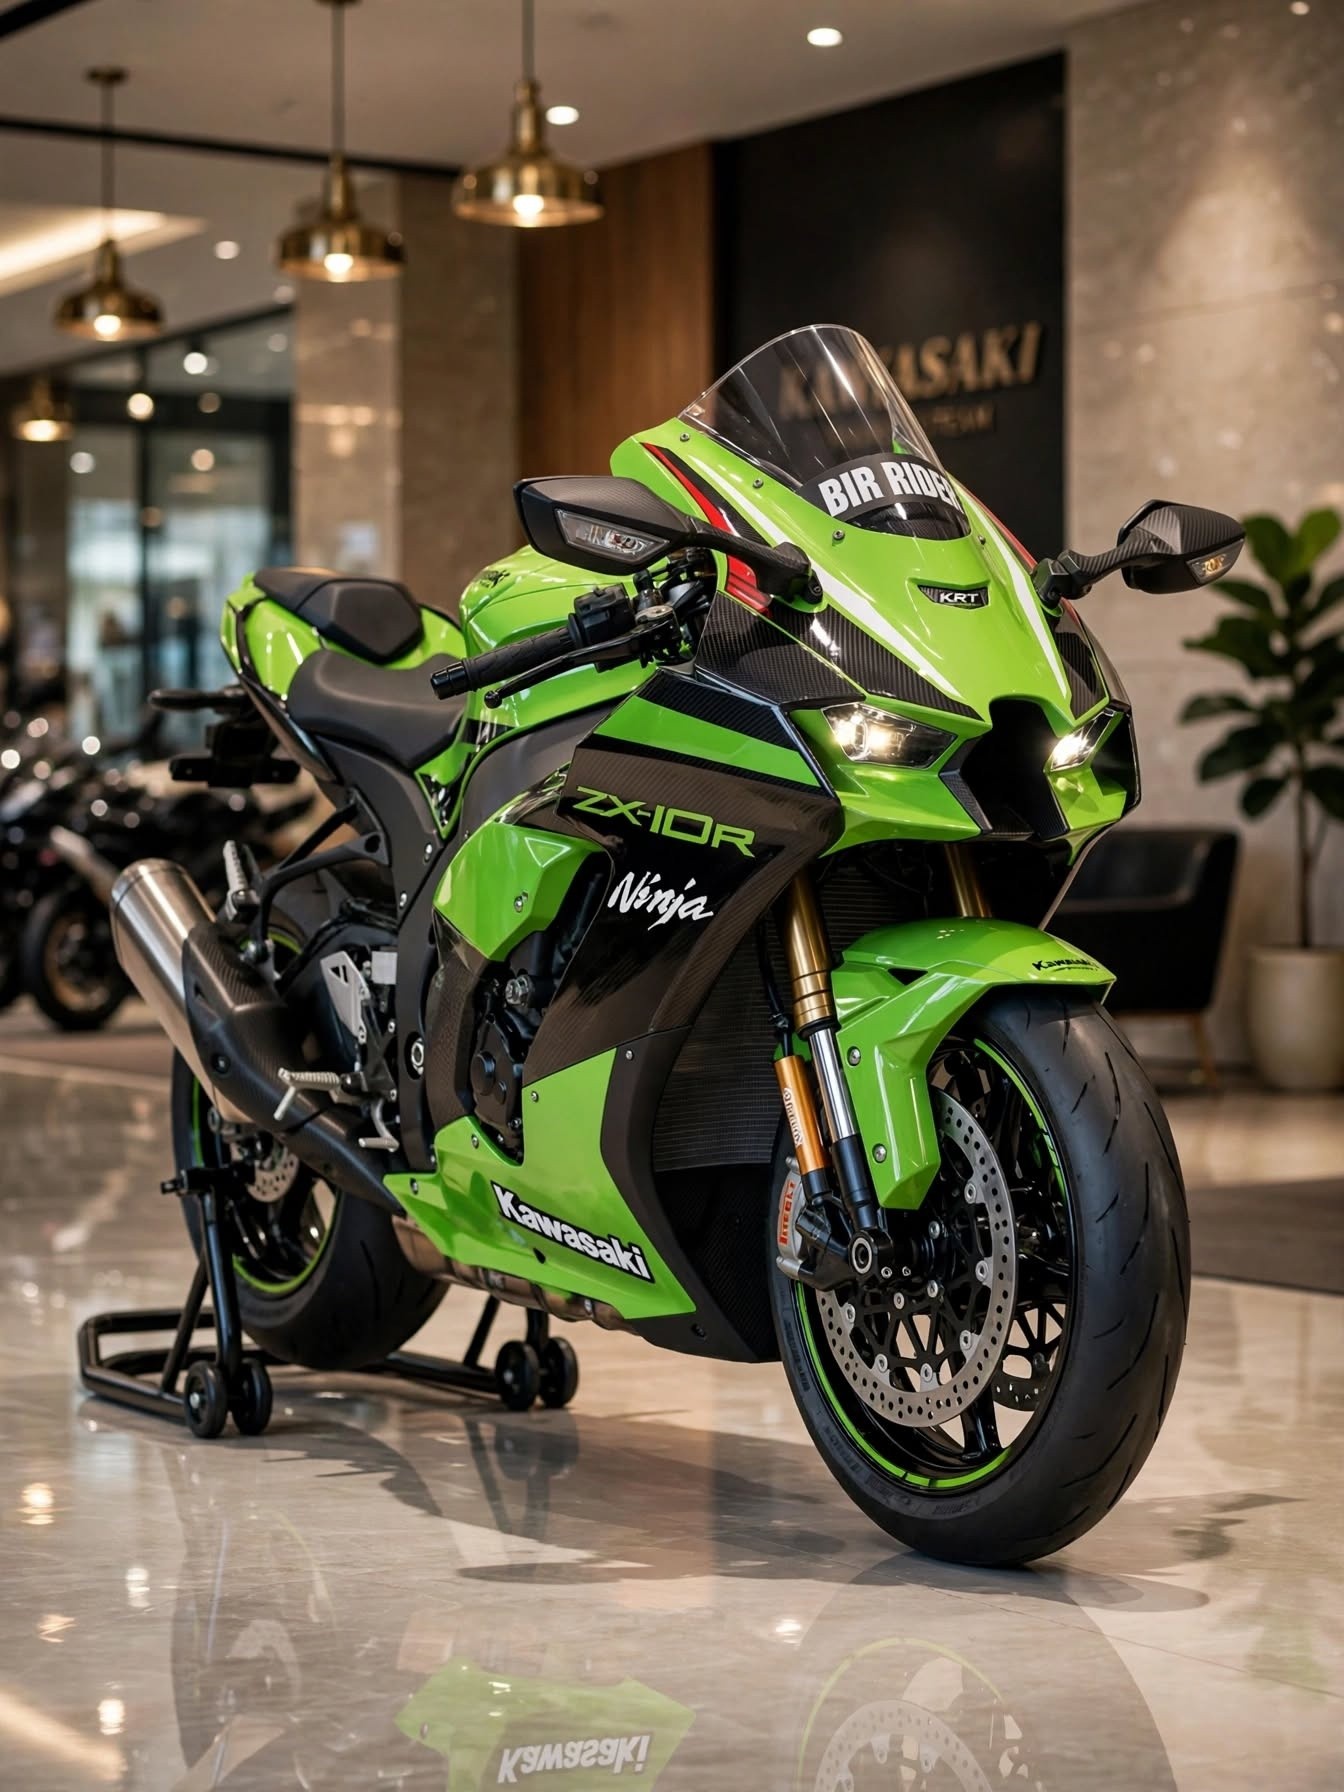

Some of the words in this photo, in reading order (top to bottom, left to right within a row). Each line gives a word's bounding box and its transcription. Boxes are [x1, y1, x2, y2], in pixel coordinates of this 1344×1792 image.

[818, 466, 885, 517] BIR
[939, 592, 979, 603] KRT
[572, 785, 755, 858] ZX-10R
[607, 871, 714, 931] Ninja
[493, 1184, 651, 1280] Kawasaki
